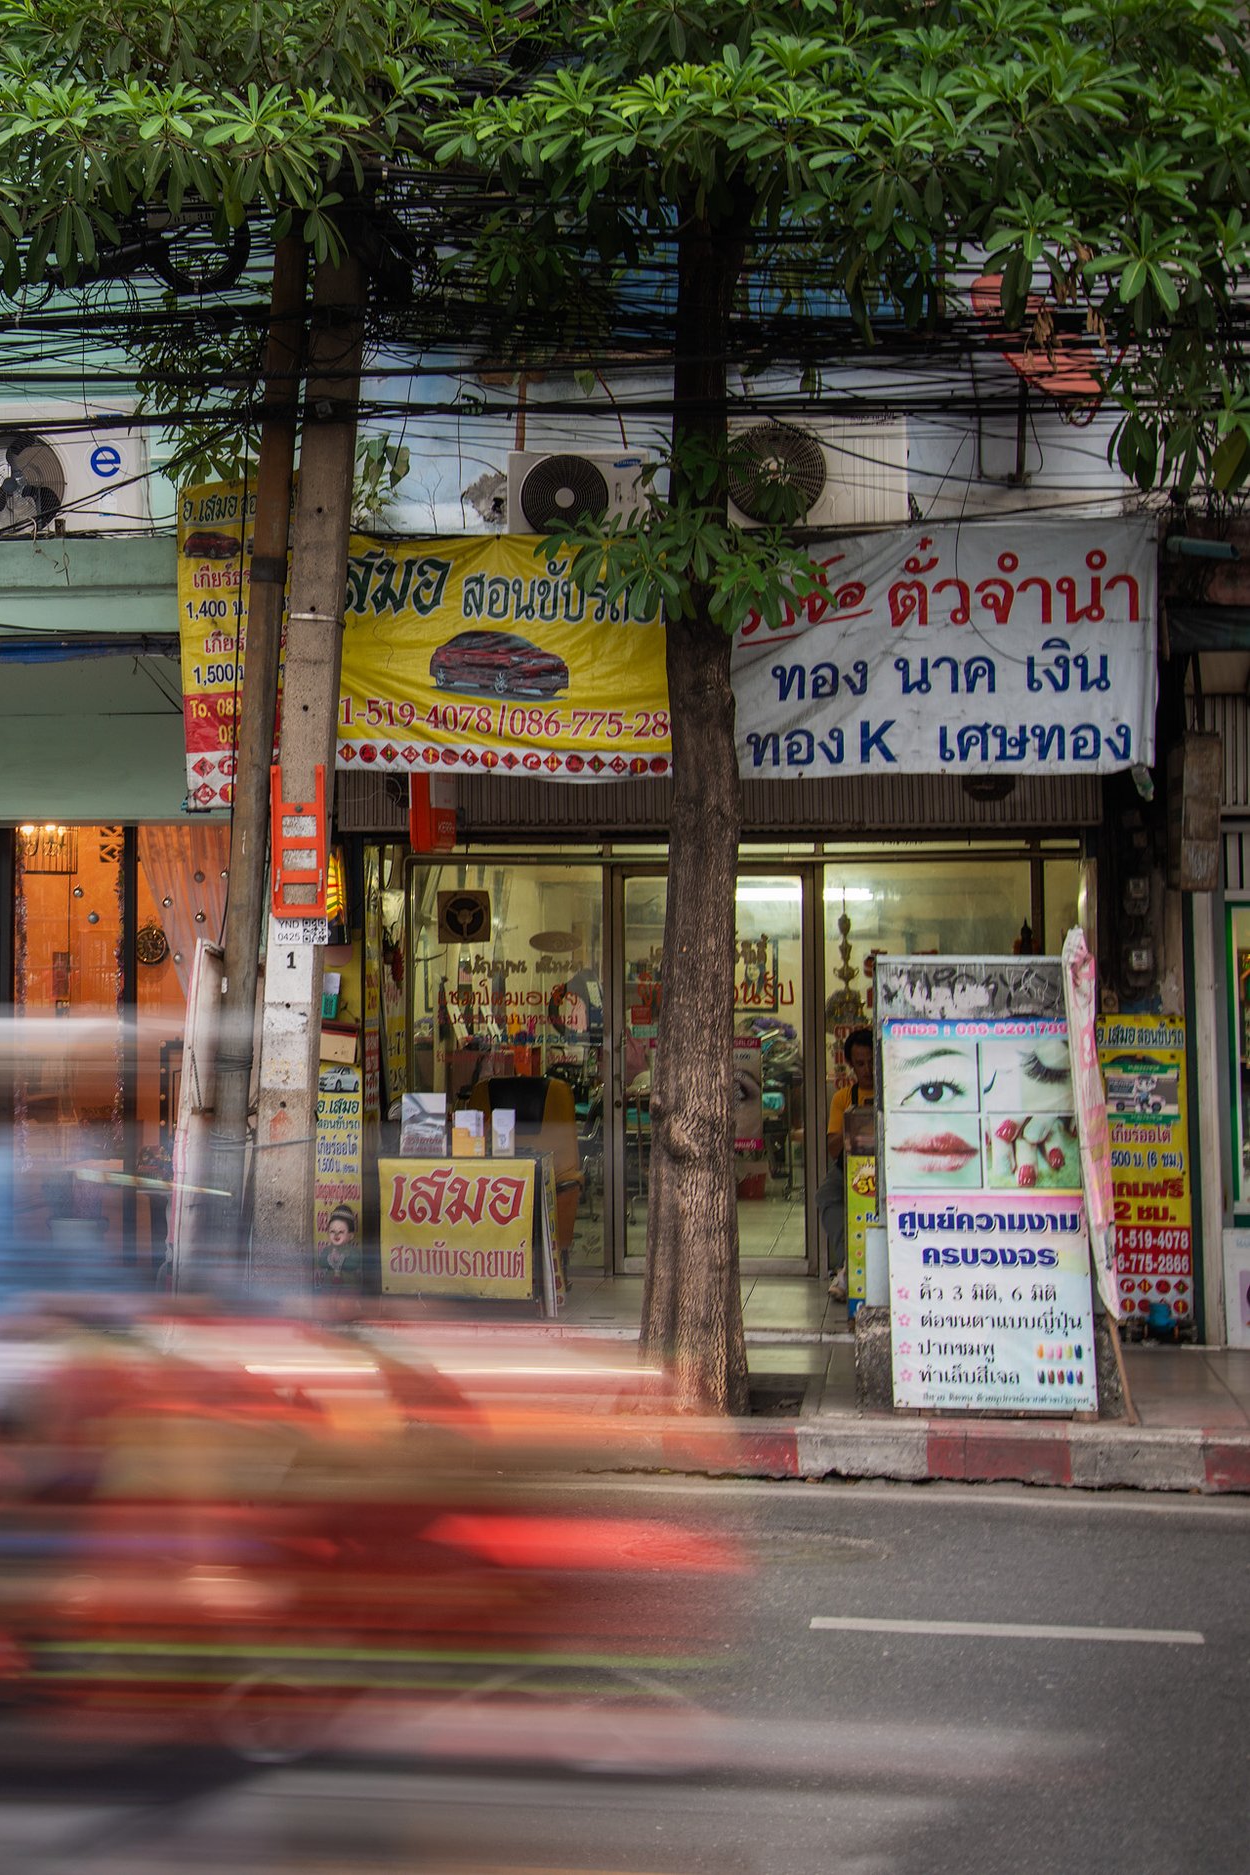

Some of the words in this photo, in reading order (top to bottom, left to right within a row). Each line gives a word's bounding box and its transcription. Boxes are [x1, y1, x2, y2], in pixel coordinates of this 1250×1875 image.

[887, 536, 1141, 628] ตั๋วจำนำ
[186, 600, 227, 621] 1,400
[193, 663, 234, 686] 1,500
[771, 657, 869, 702] ทอง
[894, 655, 997, 695] นาค
[1026, 637, 1112, 694] เงิน
[190, 700, 211, 719] To.
[746, 725, 845, 767] ทอง
[859, 719, 897, 763] K
[938, 720, 1132, 763] เศษทอง
[279, 919, 300, 928] YND
[277, 932, 301, 942] 0425
[286, 951, 297, 970] 1
[317, 1097, 360, 1115] อ.เสมอ
[1111, 1122, 1172, 1143] เกียร์ออโต้
[389, 1166, 526, 1226] เสมอ
[1114, 1201, 1132, 1220] 2
[898, 1206, 1081, 1238] ศูนย์ความงาม
[389, 1239, 526, 1279] สอนขับรถยนต์
[922, 1246, 1059, 1267] ครบวงจร
[952, 1285, 963, 1301] 3
[1011, 1285, 1023, 1301] 6
[920, 1306, 1083, 1337] ต่อขนตาแบบญี่ปุ่น
[917, 1340, 995, 1363] ปากชมพู
[918, 1364, 1020, 1385] ทำเล็บสีเจล
